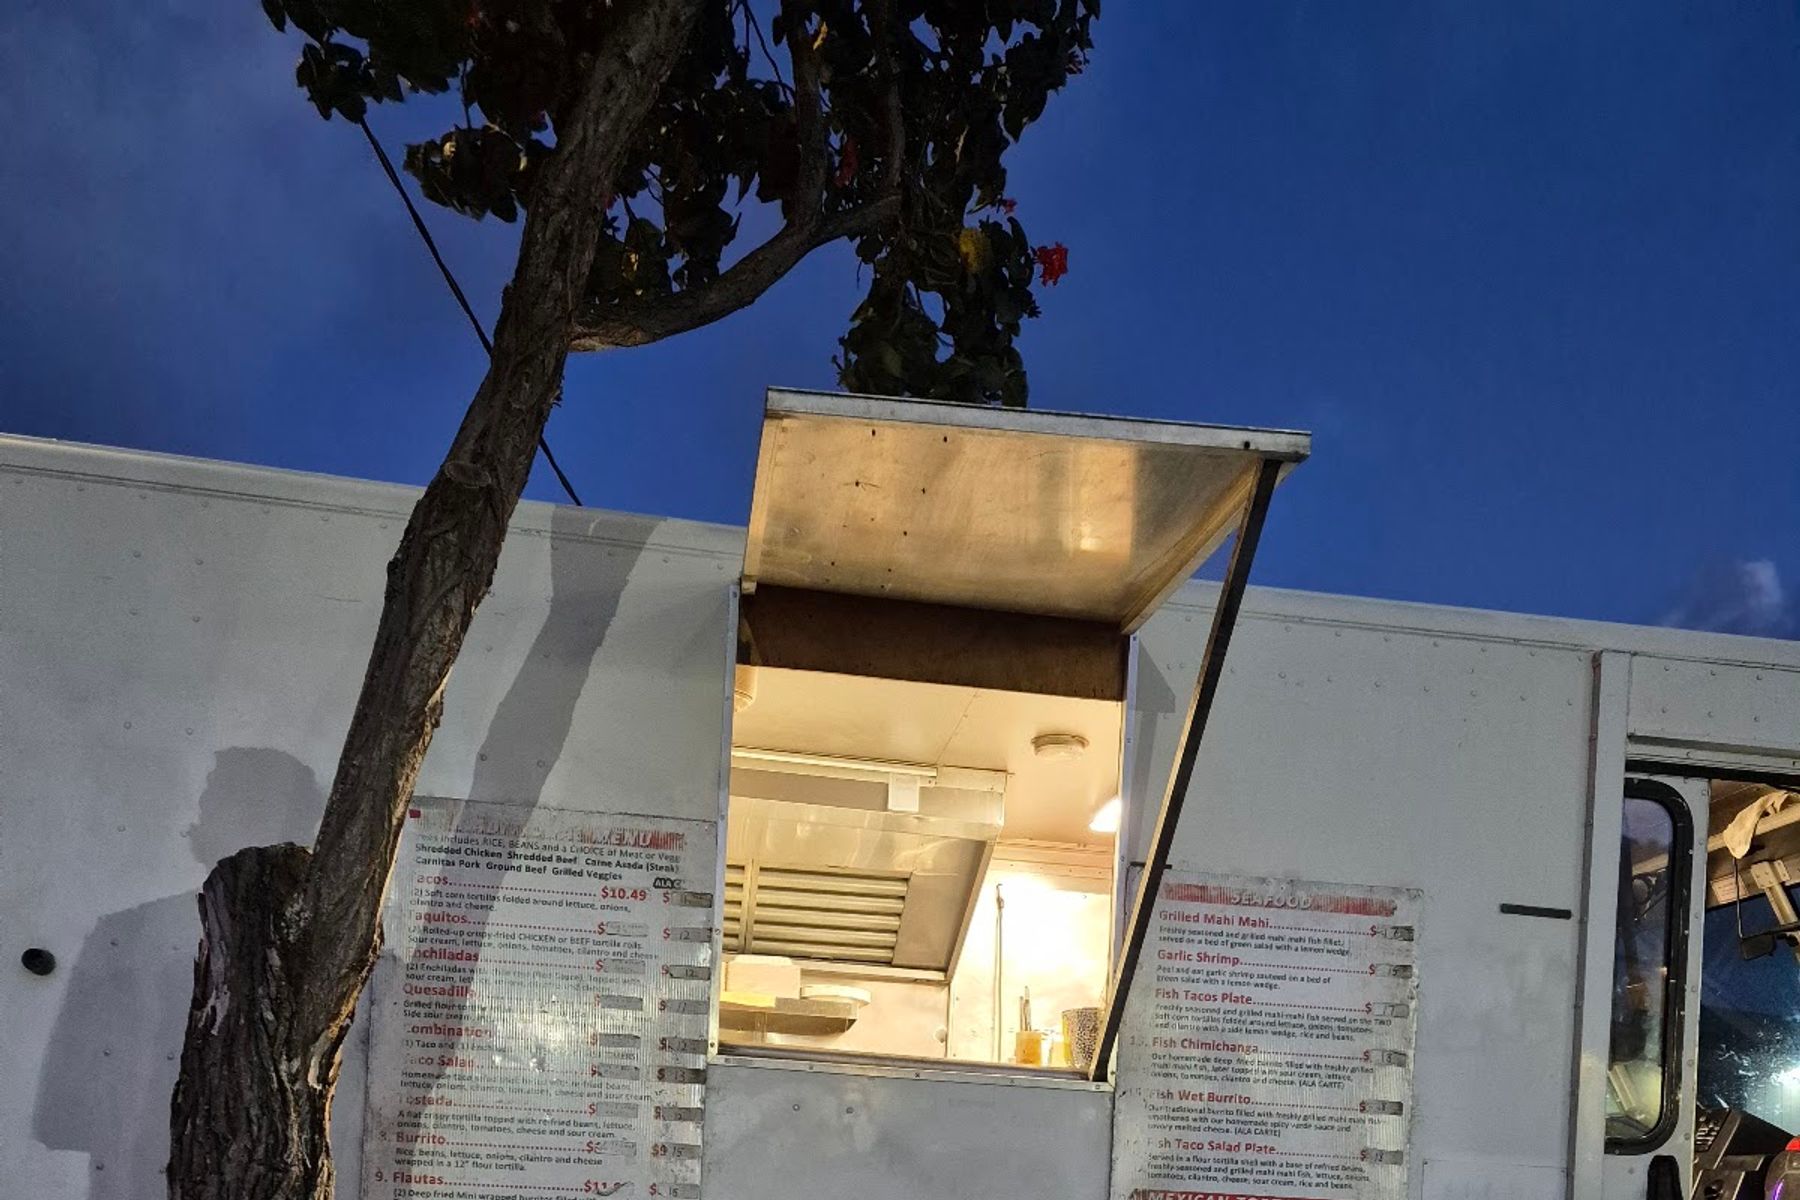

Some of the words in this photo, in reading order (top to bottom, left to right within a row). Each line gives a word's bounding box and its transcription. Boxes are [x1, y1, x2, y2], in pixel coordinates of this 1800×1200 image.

[415, 843, 462, 855] Shredded
[464, 847, 502, 858] Chicken
[507, 851, 552, 863] Shredded
[556, 855, 577, 865] Beef
[584, 857, 612, 867] Carne
[615, 859, 643, 870] Asada
[414, 855, 455, 867] Carnitas
[459, 859, 480, 869] Pork
[485, 861, 522, 872] Ground
[525, 864, 546, 874] Beef
[551, 866, 583, 877] Grilled
[586, 869, 622, 882] Veggies
[600, 885, 646, 902] $10.49
[1158, 910, 1199, 923] Grilled
[1203, 913, 1234, 925] Mahi
[1238, 915, 1269, 928] Mahi
[1157, 949, 1193, 961] Garlic
[1195, 952, 1239, 966] Shrimp
[1154, 988, 1178, 1000] Fish
[1183, 990, 1217, 1002] Tacos
[1221, 992, 1252, 1004] Plate
[1152, 1036, 1175, 1048] Fish
[1180, 1038, 1258, 1055] Chimichanga
[1178, 1091, 1205, 1102] Wet
[1207, 1092, 1251, 1104] Burrito
[1175, 1139, 1203, 1150] Taco
[1207, 1141, 1241, 1152] Salad
[1244, 1143, 1276, 1154] Plate
[375, 1171, 388, 1182] 9.
[392, 1172, 444, 1185] Flautas
[408, 1187, 430, 1200] Deep
[432, 1189, 454, 1198] fried
[457, 1190, 476, 1199] Mini
